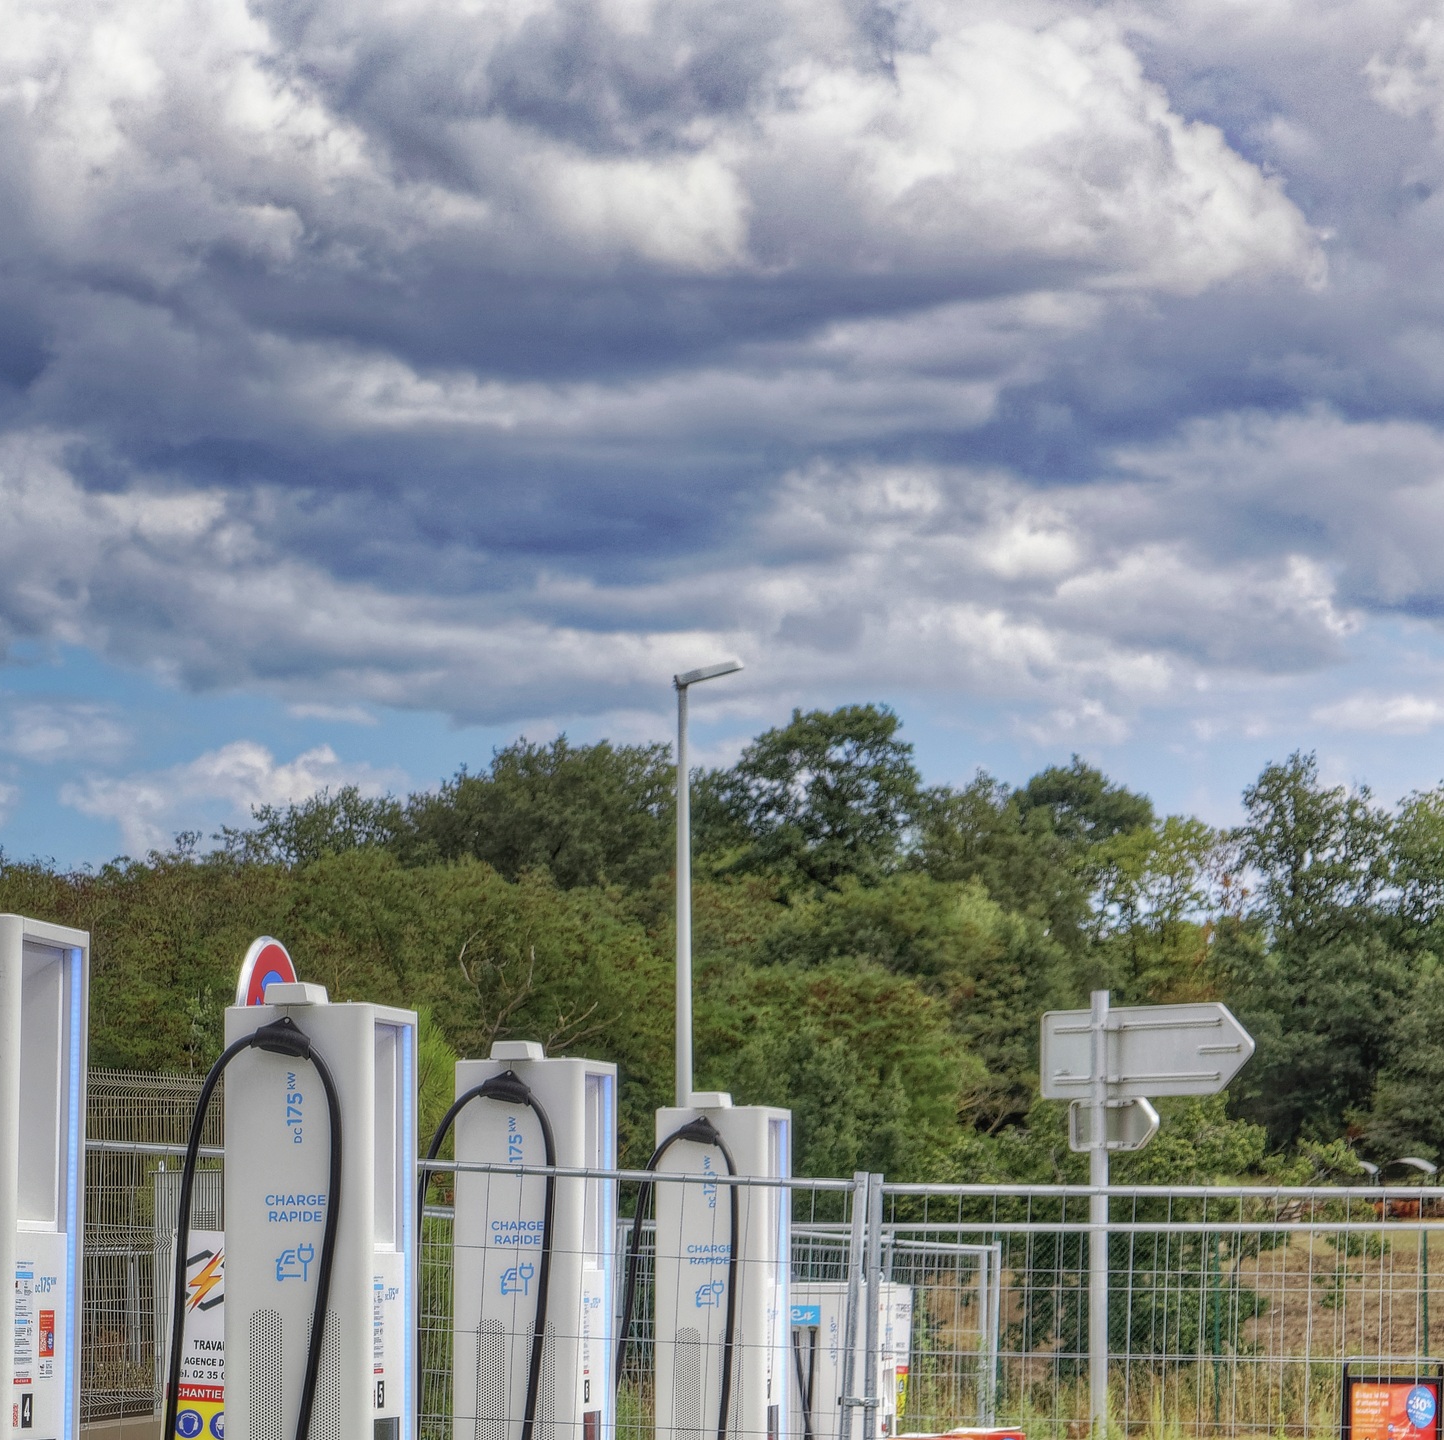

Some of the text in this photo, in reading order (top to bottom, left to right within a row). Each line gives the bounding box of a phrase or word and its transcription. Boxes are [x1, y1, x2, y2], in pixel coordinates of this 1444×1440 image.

[265, 1195, 326, 1206] CHARGE
[269, 1211, 323, 1222] RAPIDE
[491, 1220, 544, 1231] CHARGE
[494, 1235, 541, 1245] RAPIDE
[184, 1357, 216, 1366] AGENCE
[193, 1370, 204, 1379] 02
[207, 1371, 218, 1379] 35
[378, 1383, 383, 1401] 5
[23, 1397, 30, 1421] 4
